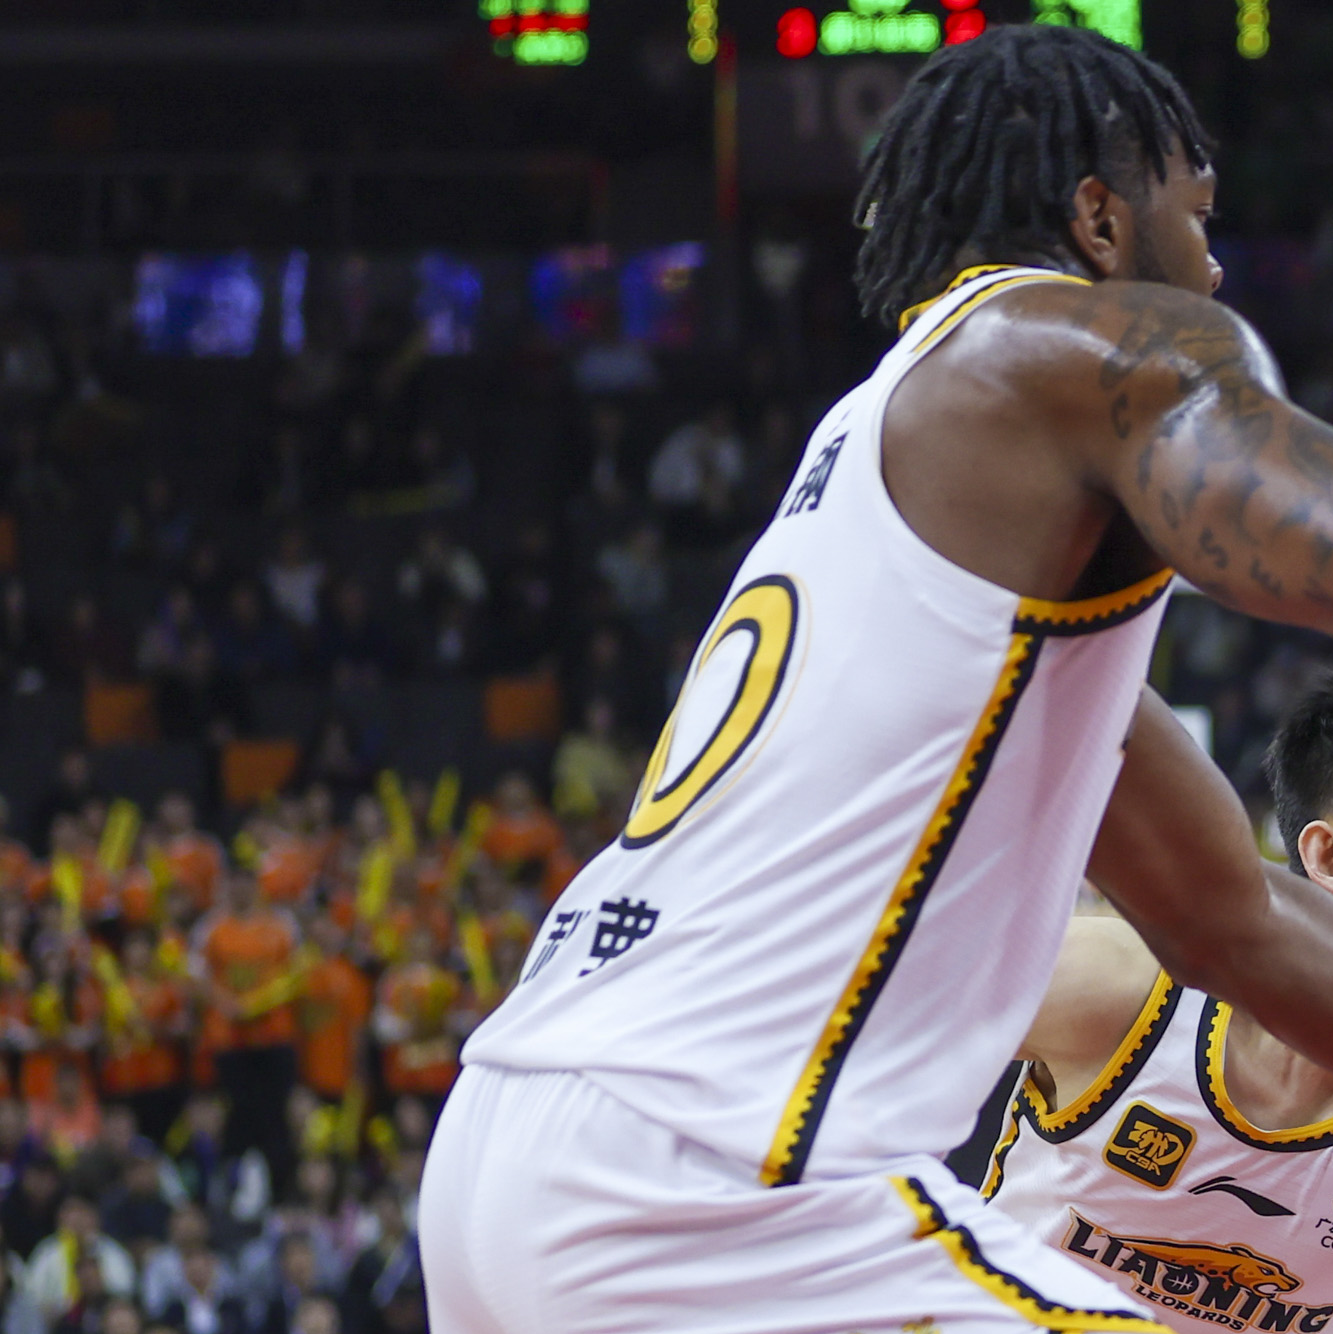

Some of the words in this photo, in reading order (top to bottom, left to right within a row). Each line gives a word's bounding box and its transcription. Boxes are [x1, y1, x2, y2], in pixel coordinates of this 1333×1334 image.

[787, 66, 900, 142] 10
[1125, 1150, 1161, 1176] CBA
[1135, 1284, 1246, 1331] LEOPARDS
